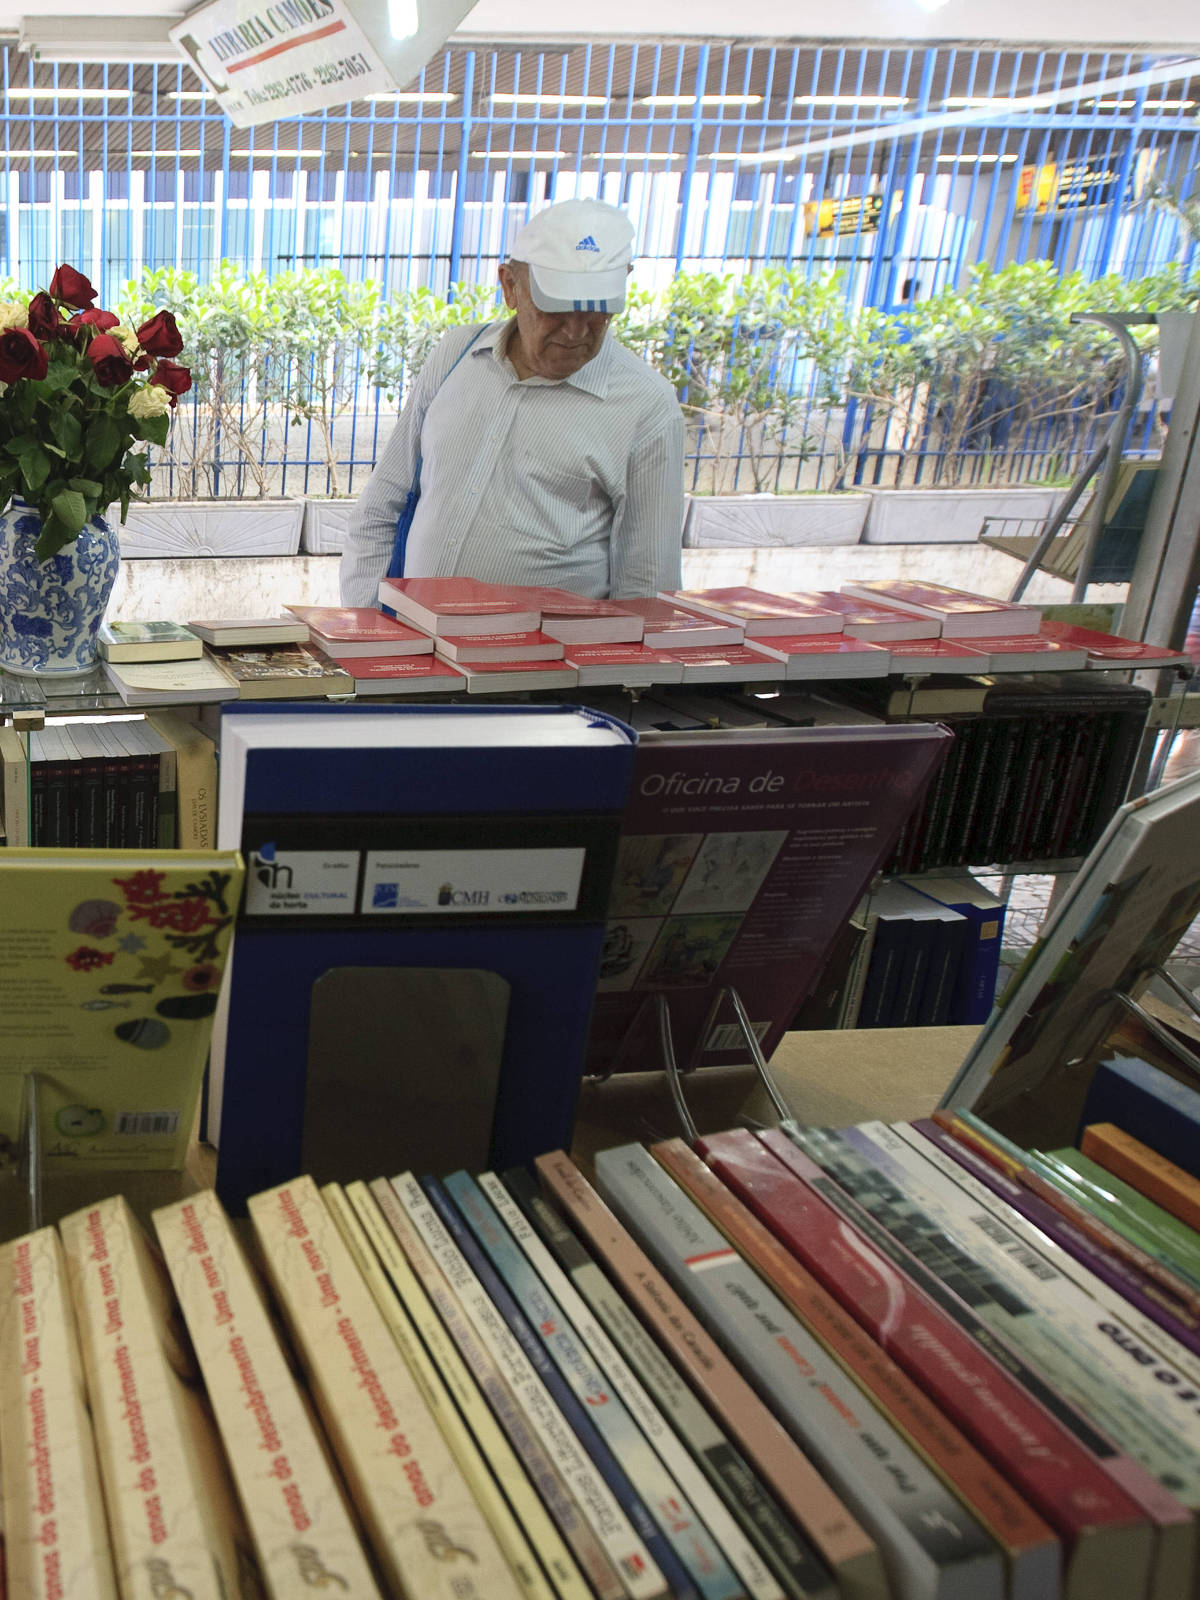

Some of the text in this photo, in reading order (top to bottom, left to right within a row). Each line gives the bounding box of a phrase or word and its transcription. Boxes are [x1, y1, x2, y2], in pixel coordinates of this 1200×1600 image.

[208, 16, 275, 62] LIVRARIA
[640, 771, 740, 797] Oficina
[749, 770, 785, 793] de
[450, 891, 490, 906] CMH
[415, 1209, 451, 1250] Lucas
[199, 1256, 222, 1290] nova
[300, 1239, 326, 1274] nova
[99, 1263, 116, 1297] nova
[319, 1272, 341, 1309] Uma
[22, 1298, 39, 1334] nova
[104, 1298, 123, 1335] Uma
[214, 1290, 236, 1327] Uma
[22, 1336, 41, 1376] Uma
[335, 1317, 399, 1432] descobrimento
[114, 1346, 152, 1464] descobrimento
[228, 1335, 282, 1453] descobrimento
[28, 1387, 56, 1515] descobrimento
[385, 1433, 412, 1459] do
[134, 1467, 158, 1494] do
[268, 1455, 293, 1481] do
[402, 1459, 435, 1508] anos
[144, 1496, 169, 1545] anos
[280, 1483, 313, 1532] anos
[36, 1519, 57, 1546] do
